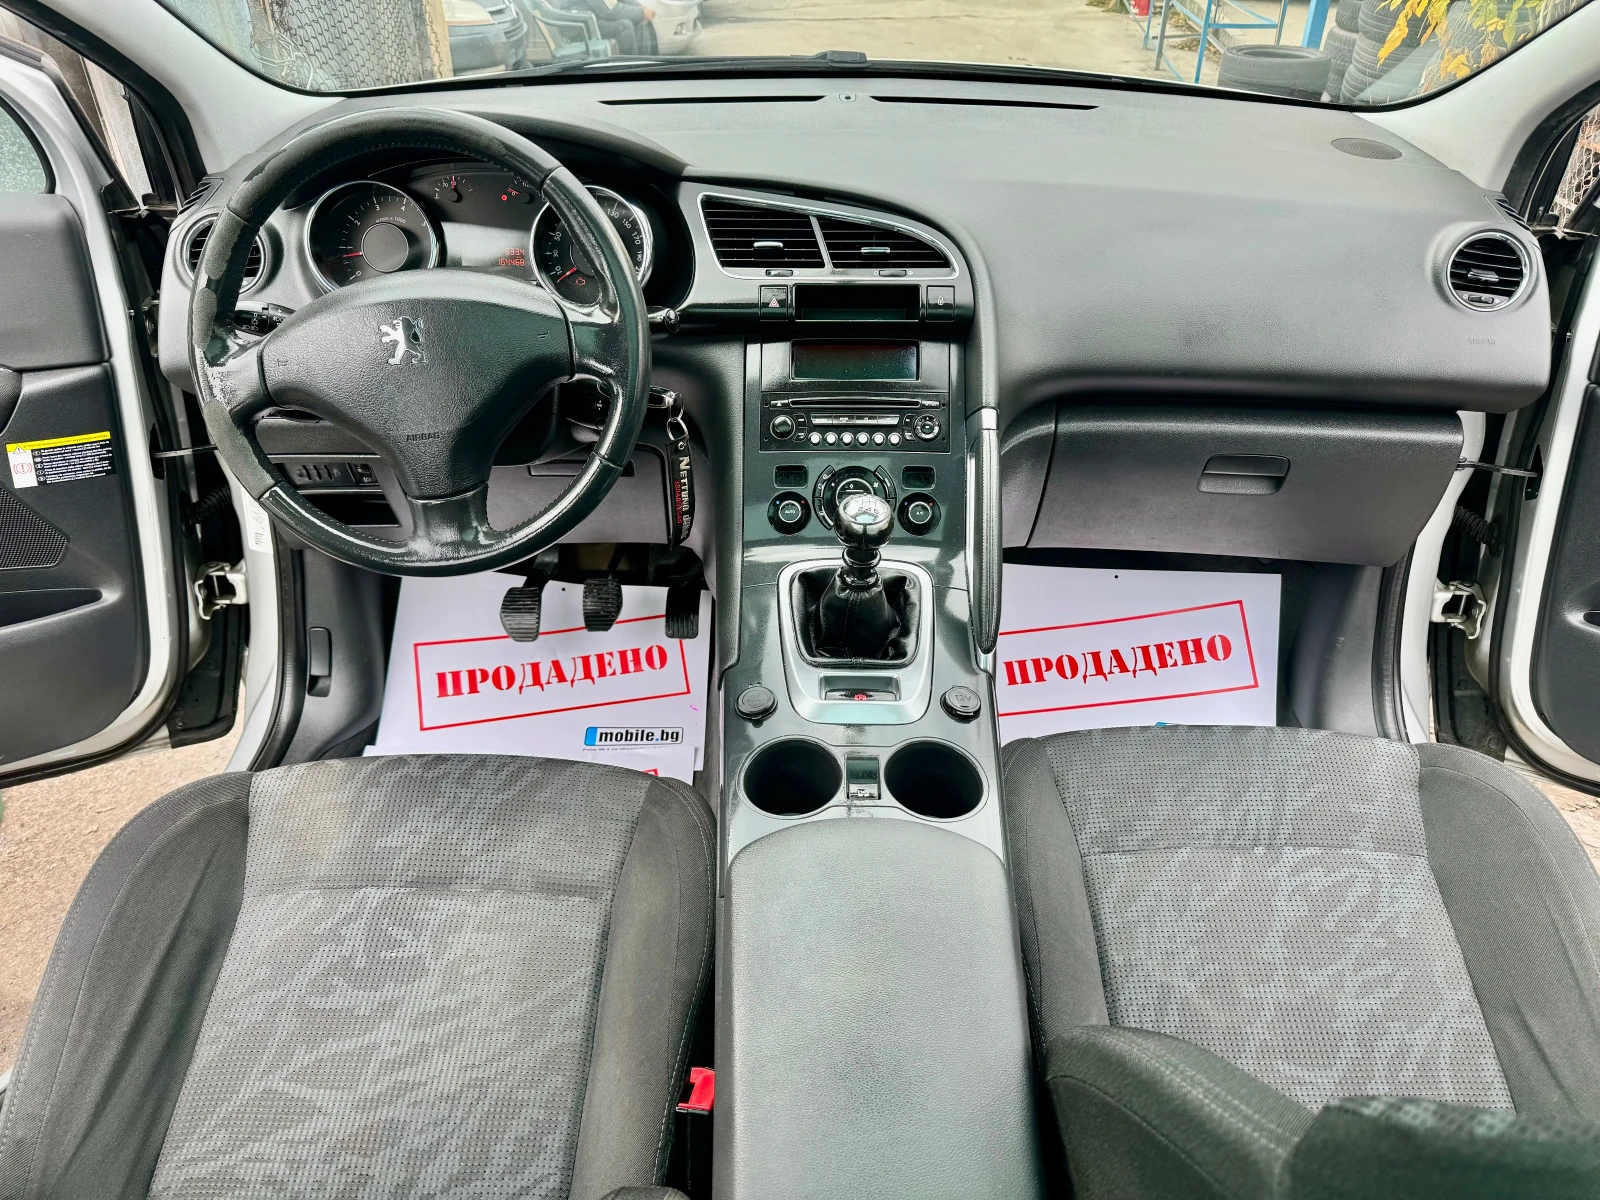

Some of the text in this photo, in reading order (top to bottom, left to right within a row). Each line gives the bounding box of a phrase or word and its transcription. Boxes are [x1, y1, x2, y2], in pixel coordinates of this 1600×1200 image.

[607, 208, 620, 219] 130
[394, 216, 406, 224] 1000
[622, 218, 632, 229] 150
[554, 231, 562, 242] 50
[631, 231, 641, 245] 170
[505, 247, 525, 256] 6334
[554, 265, 563, 276] 10
[406, 432, 441, 442] AIRBAG
[1002, 634, 1233, 686] ПРОДАДЕНО
[435, 644, 669, 698] ПРОДАДЕНО
[598, 729, 680, 743] mobile.bg
